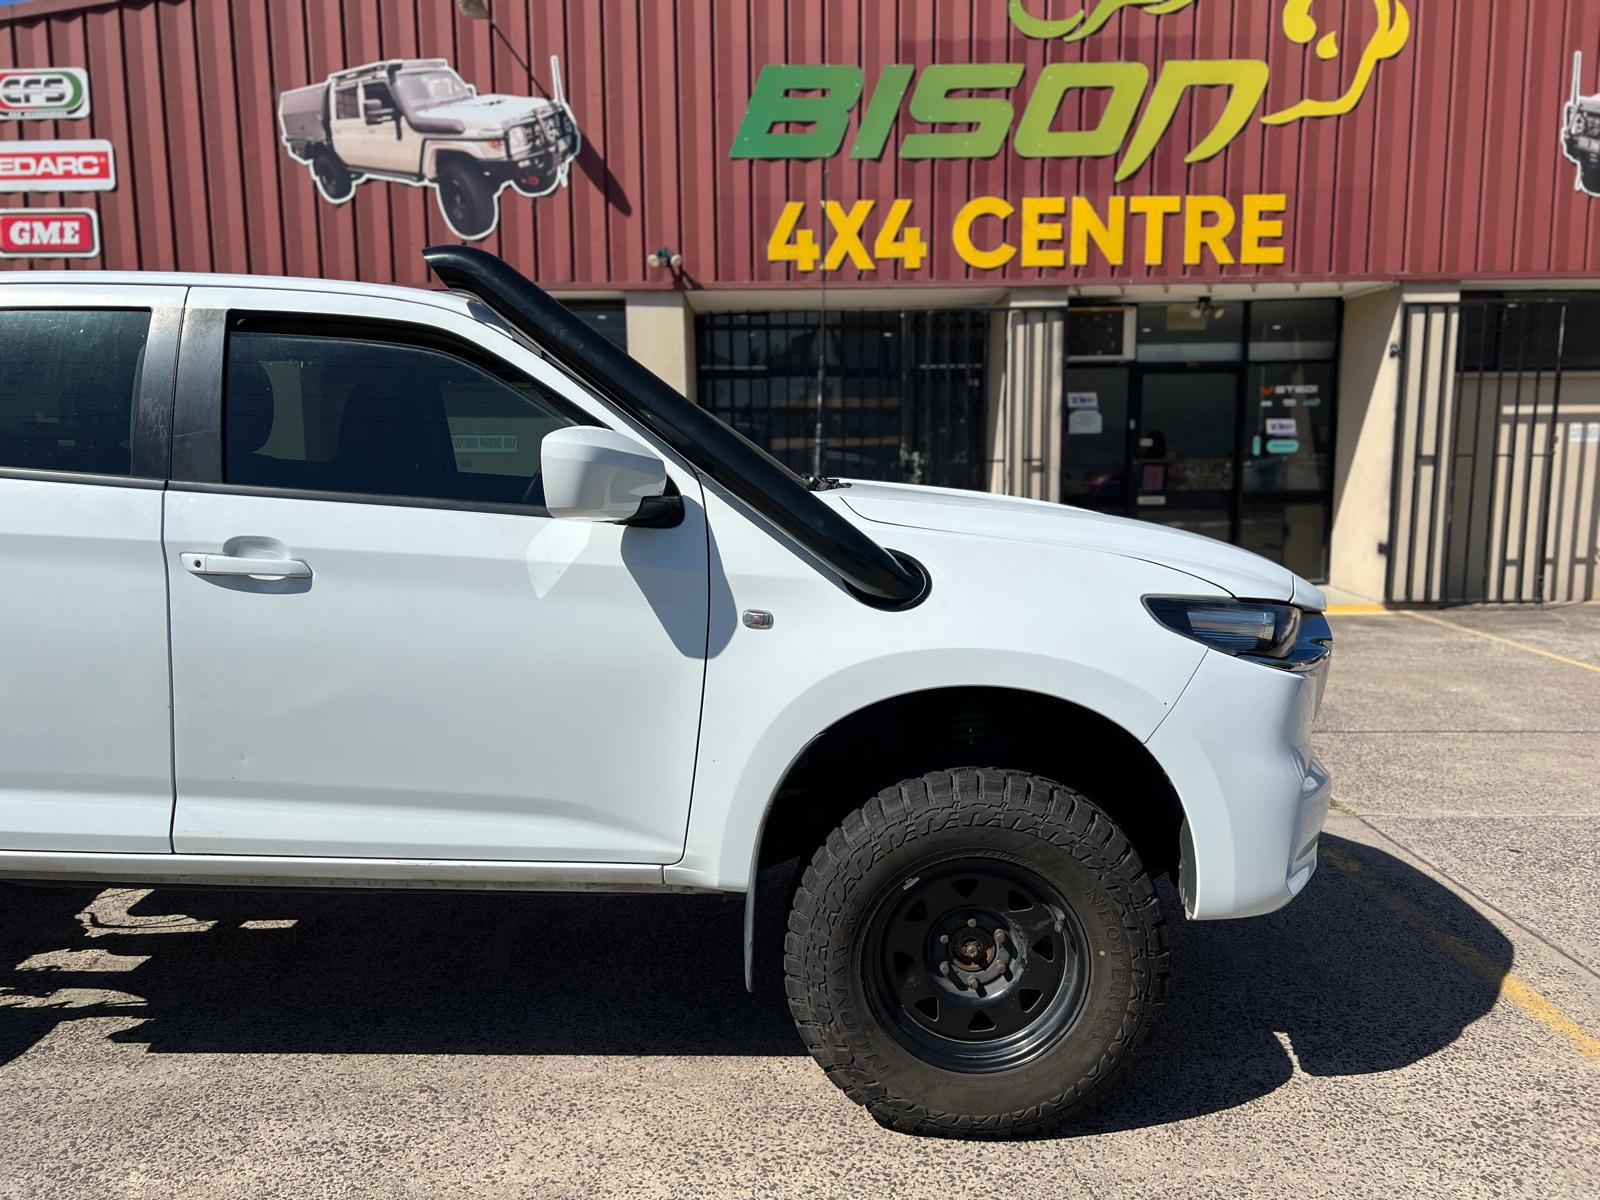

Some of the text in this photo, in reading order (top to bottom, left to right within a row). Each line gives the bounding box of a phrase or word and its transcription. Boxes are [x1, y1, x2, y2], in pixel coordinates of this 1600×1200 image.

[729, 59, 1269, 182] BISON
[0, 155, 101, 176] EDARC
[9, 220, 80, 246] GME
[767, 193, 1287, 272] 4X4 CENTRE
[480, 437, 502, 449] PARKING
[503, 437, 516, 449] ONLY
